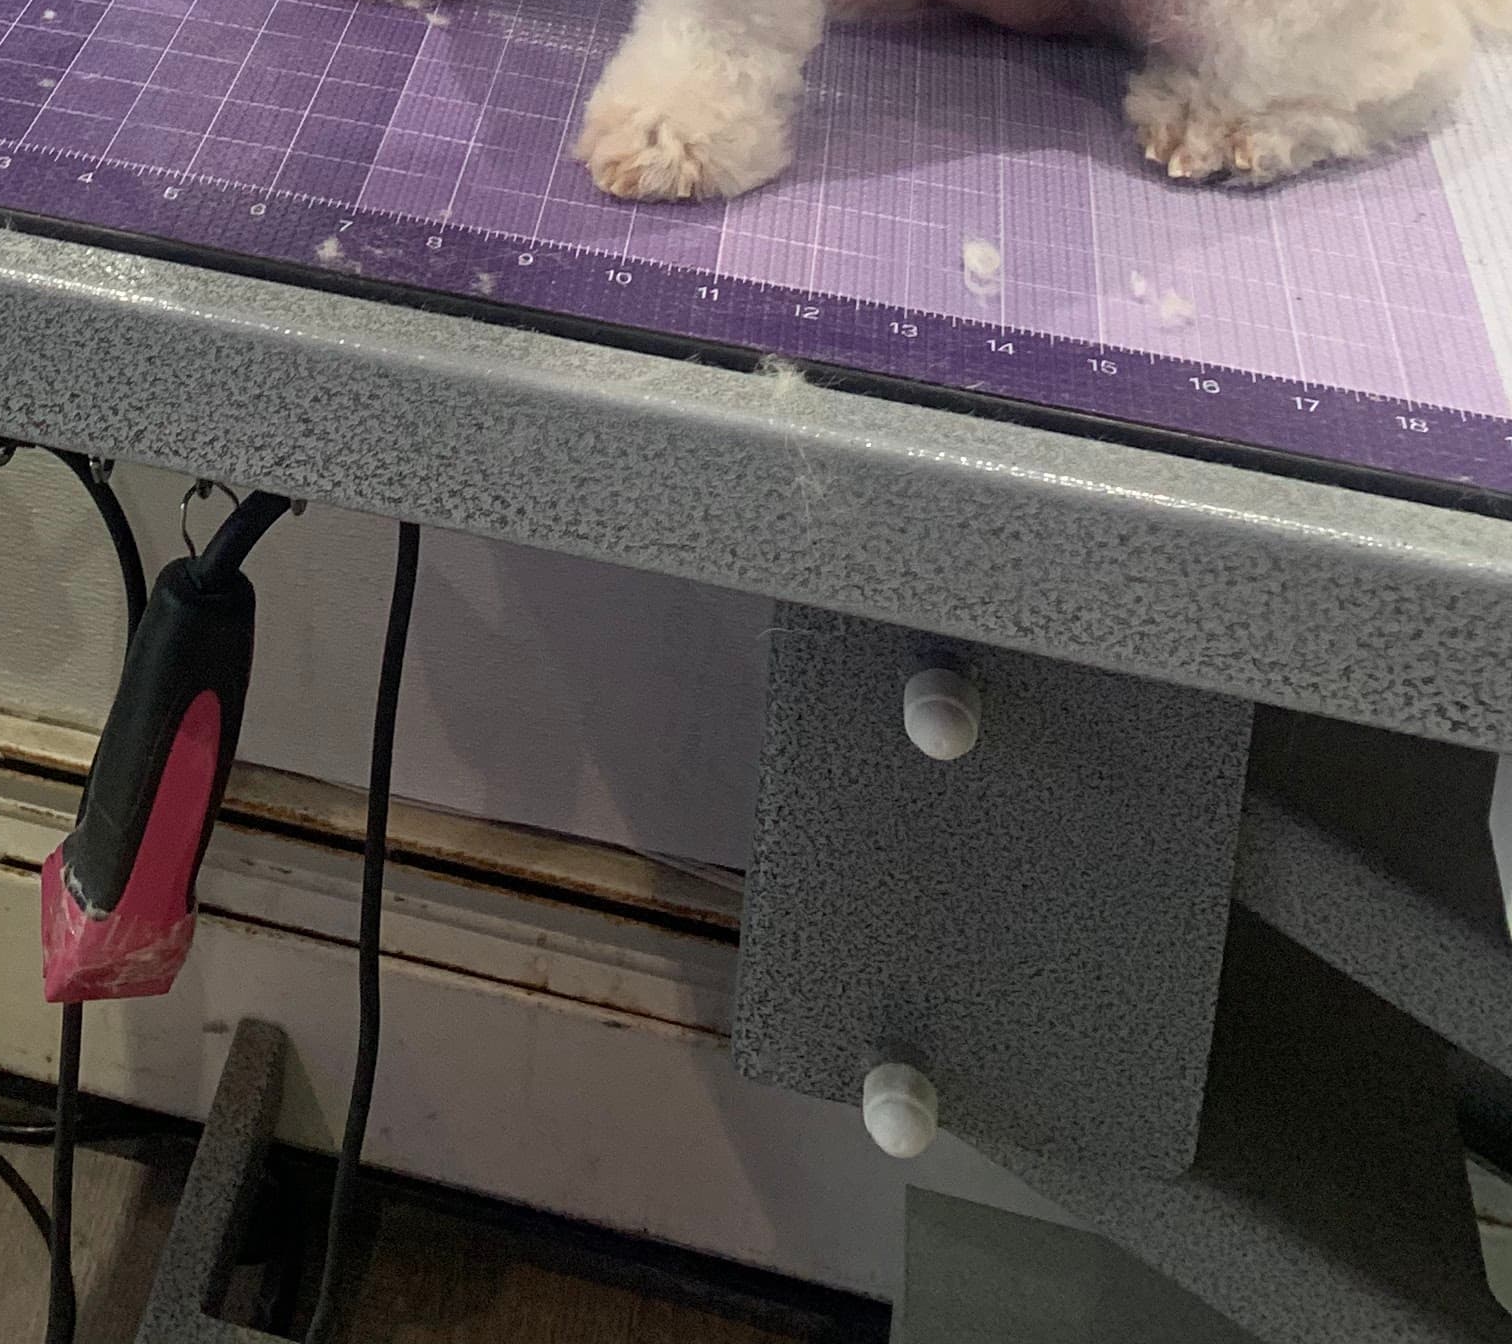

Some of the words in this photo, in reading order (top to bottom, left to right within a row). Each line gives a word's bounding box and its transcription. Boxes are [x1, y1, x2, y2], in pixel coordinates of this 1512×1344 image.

[77, 172, 94, 183] 4
[339, 220, 354, 232] 7
[426, 236, 443, 249] 8
[518, 253, 534, 266] 9
[605, 269, 633, 286] 10
[697, 286, 720, 301] 11
[794, 304, 820, 320] 12
[889, 322, 918, 338] 13
[987, 339, 1015, 355] 14
[1087, 358, 1118, 376] 15
[1189, 377, 1221, 395] 16
[1292, 396, 1321, 413] 17
[1395, 415, 1430, 433] 18
